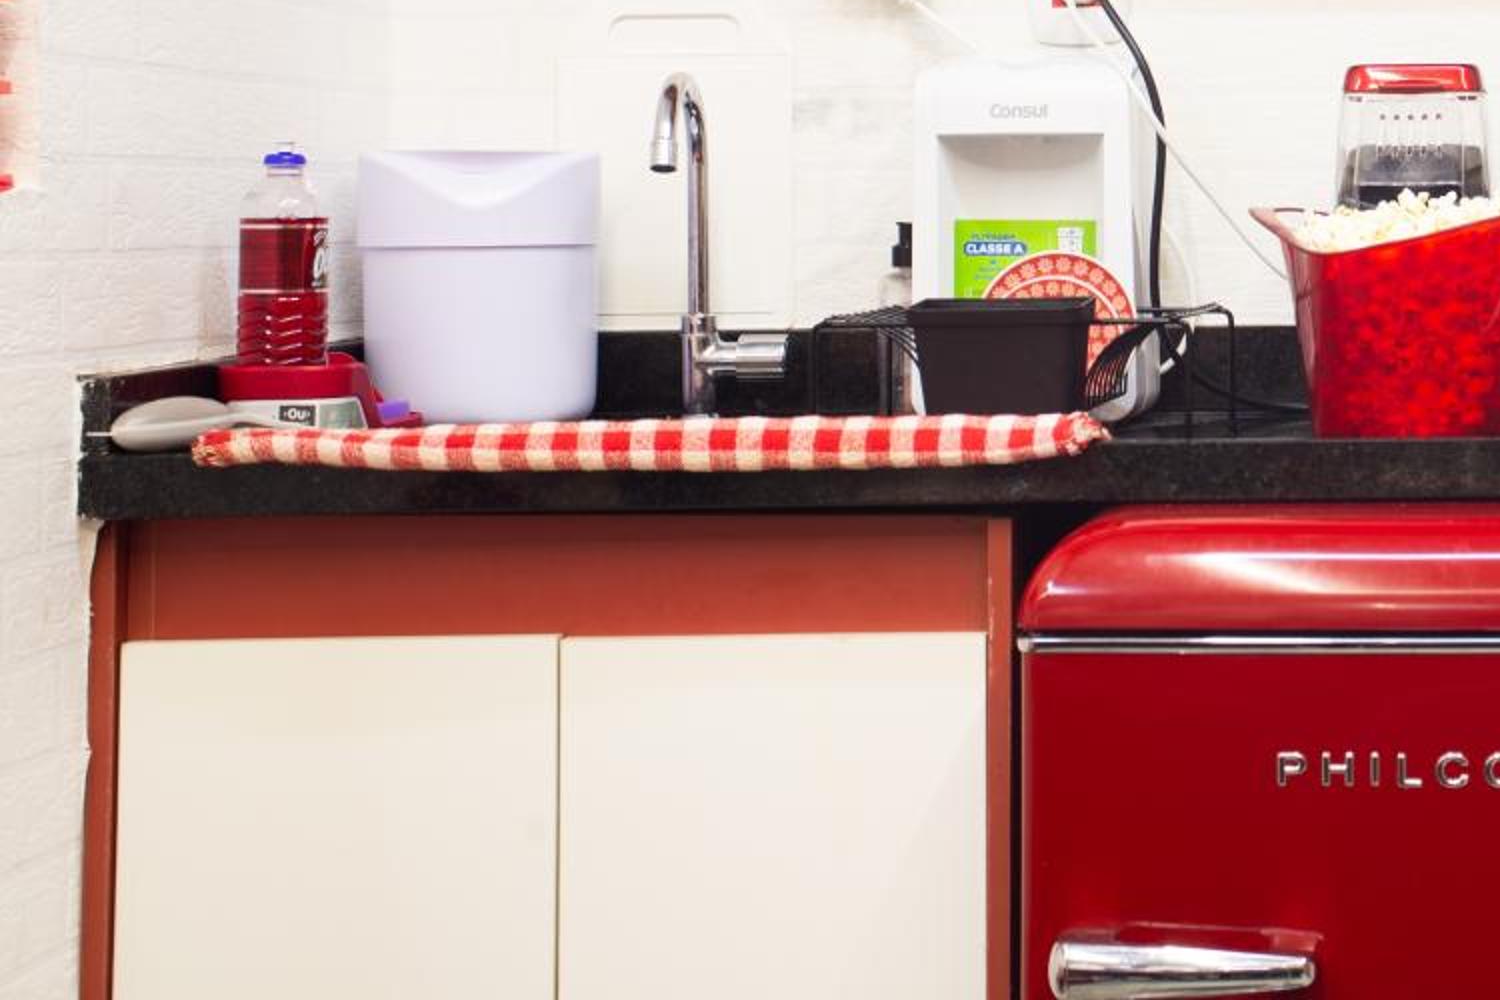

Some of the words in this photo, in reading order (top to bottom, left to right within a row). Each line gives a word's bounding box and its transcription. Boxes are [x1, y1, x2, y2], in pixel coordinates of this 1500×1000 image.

[989, 103, 1048, 119] Consul
[966, 243, 1011, 254] CLASSE
[1014, 243, 1024, 254] A
